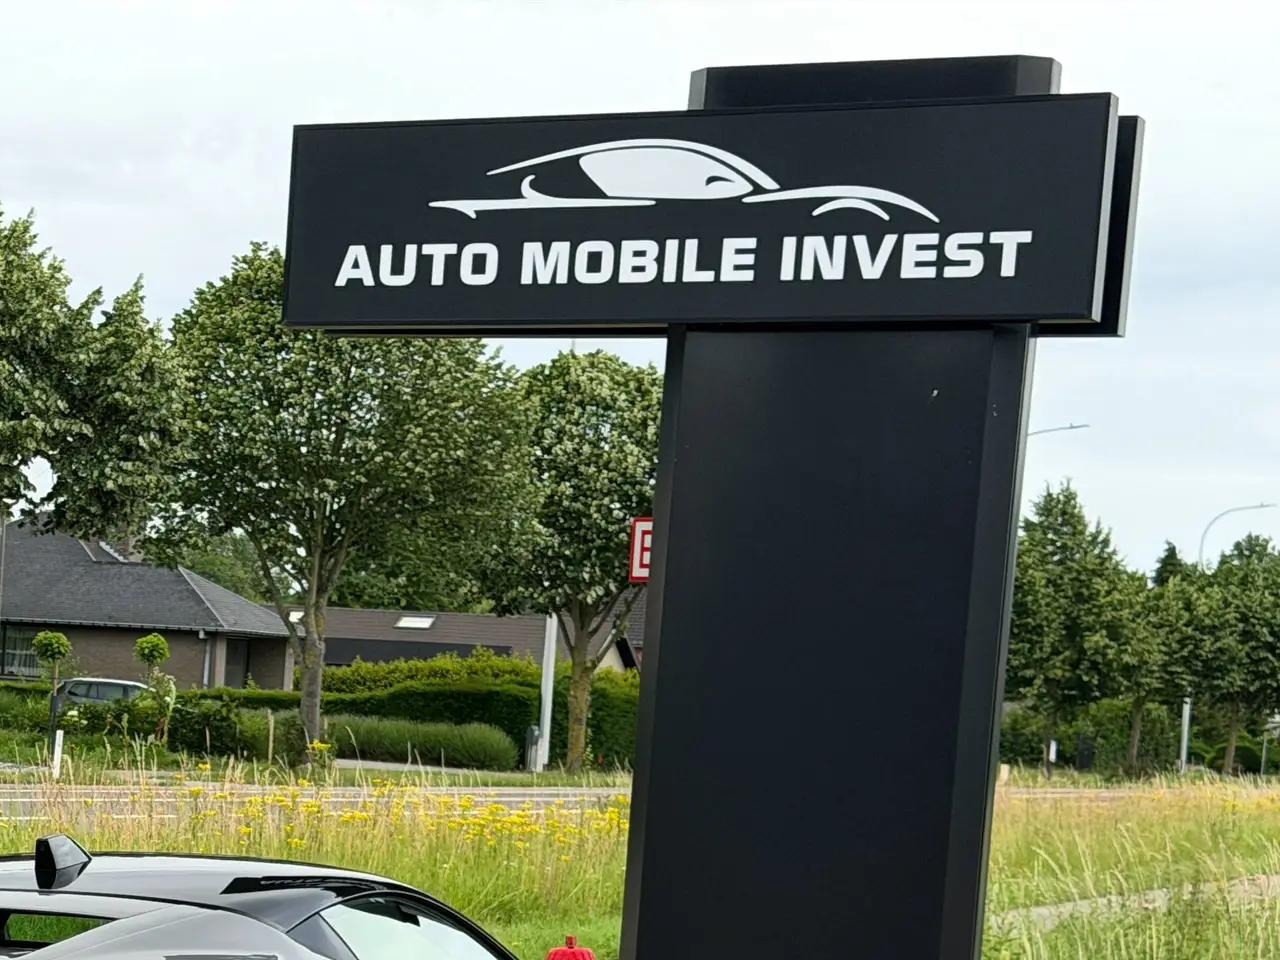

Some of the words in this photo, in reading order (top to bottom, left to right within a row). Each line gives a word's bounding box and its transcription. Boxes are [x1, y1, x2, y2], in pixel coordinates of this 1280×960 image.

[334, 242, 499, 288] AUTO
[520, 238, 758, 286] MOBILE
[779, 230, 1033, 281] INVEST
